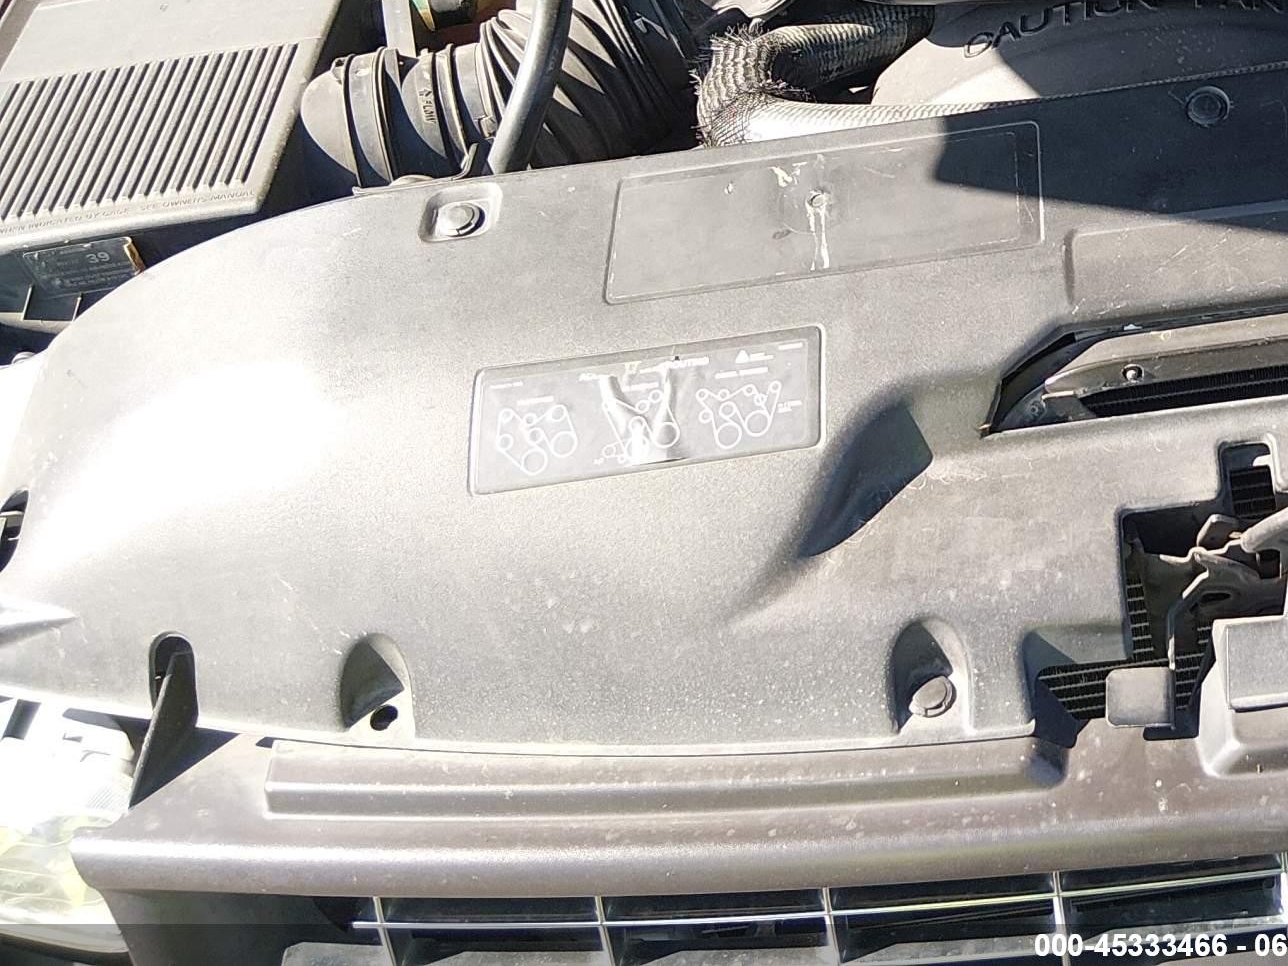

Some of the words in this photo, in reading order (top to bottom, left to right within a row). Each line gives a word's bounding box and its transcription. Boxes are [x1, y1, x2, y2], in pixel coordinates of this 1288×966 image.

[28, 214, 83, 228] INDICATED
[209, 190, 255, 202] MANUAL
[85, 251, 111, 264] 39
